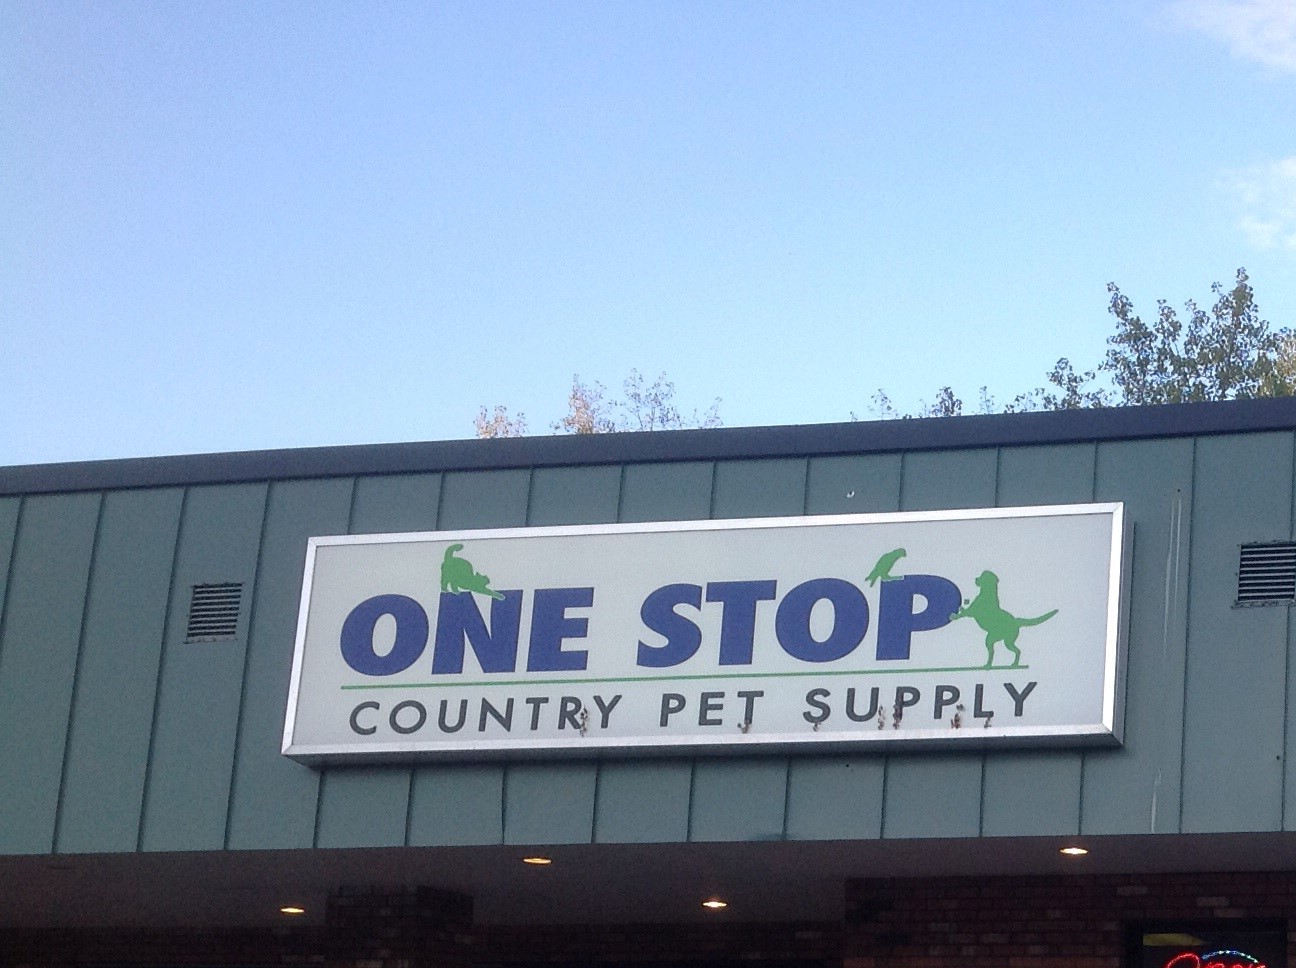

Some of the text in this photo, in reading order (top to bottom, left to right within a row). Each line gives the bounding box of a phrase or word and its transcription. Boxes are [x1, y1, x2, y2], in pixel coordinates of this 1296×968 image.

[341, 575, 962, 675] ONE STOP
[349, 681, 1038, 736] COUNTRY PET SUPPLY
